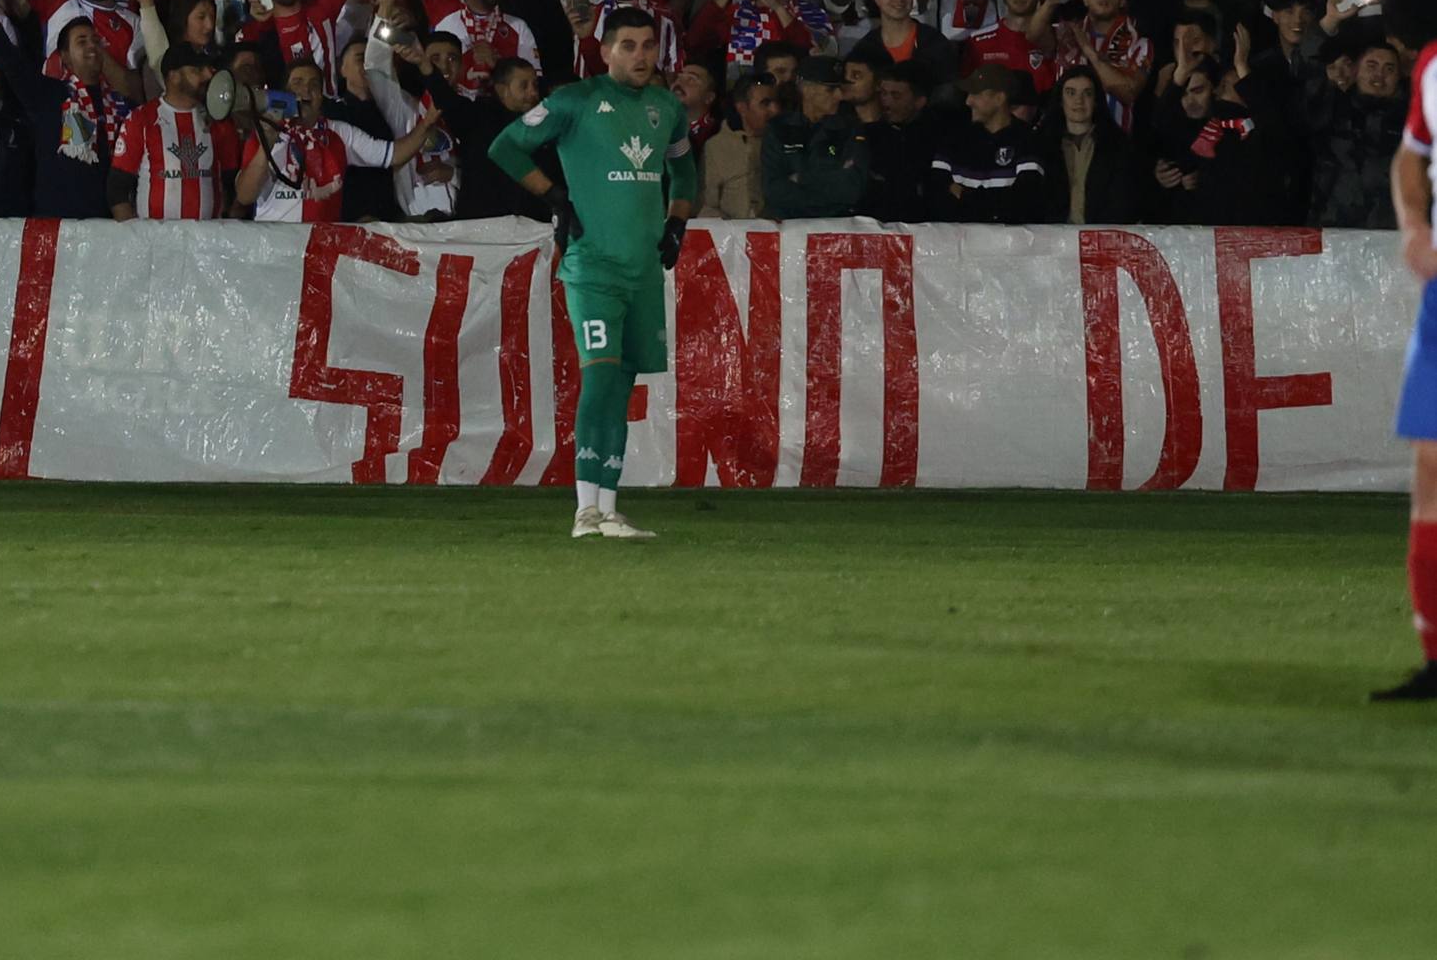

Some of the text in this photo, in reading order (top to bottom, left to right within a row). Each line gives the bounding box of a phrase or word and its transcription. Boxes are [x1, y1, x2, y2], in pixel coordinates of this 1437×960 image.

[608, 171, 636, 181] CAJA
[582, 319, 608, 351] 13
[1079, 227, 1333, 491] DE
